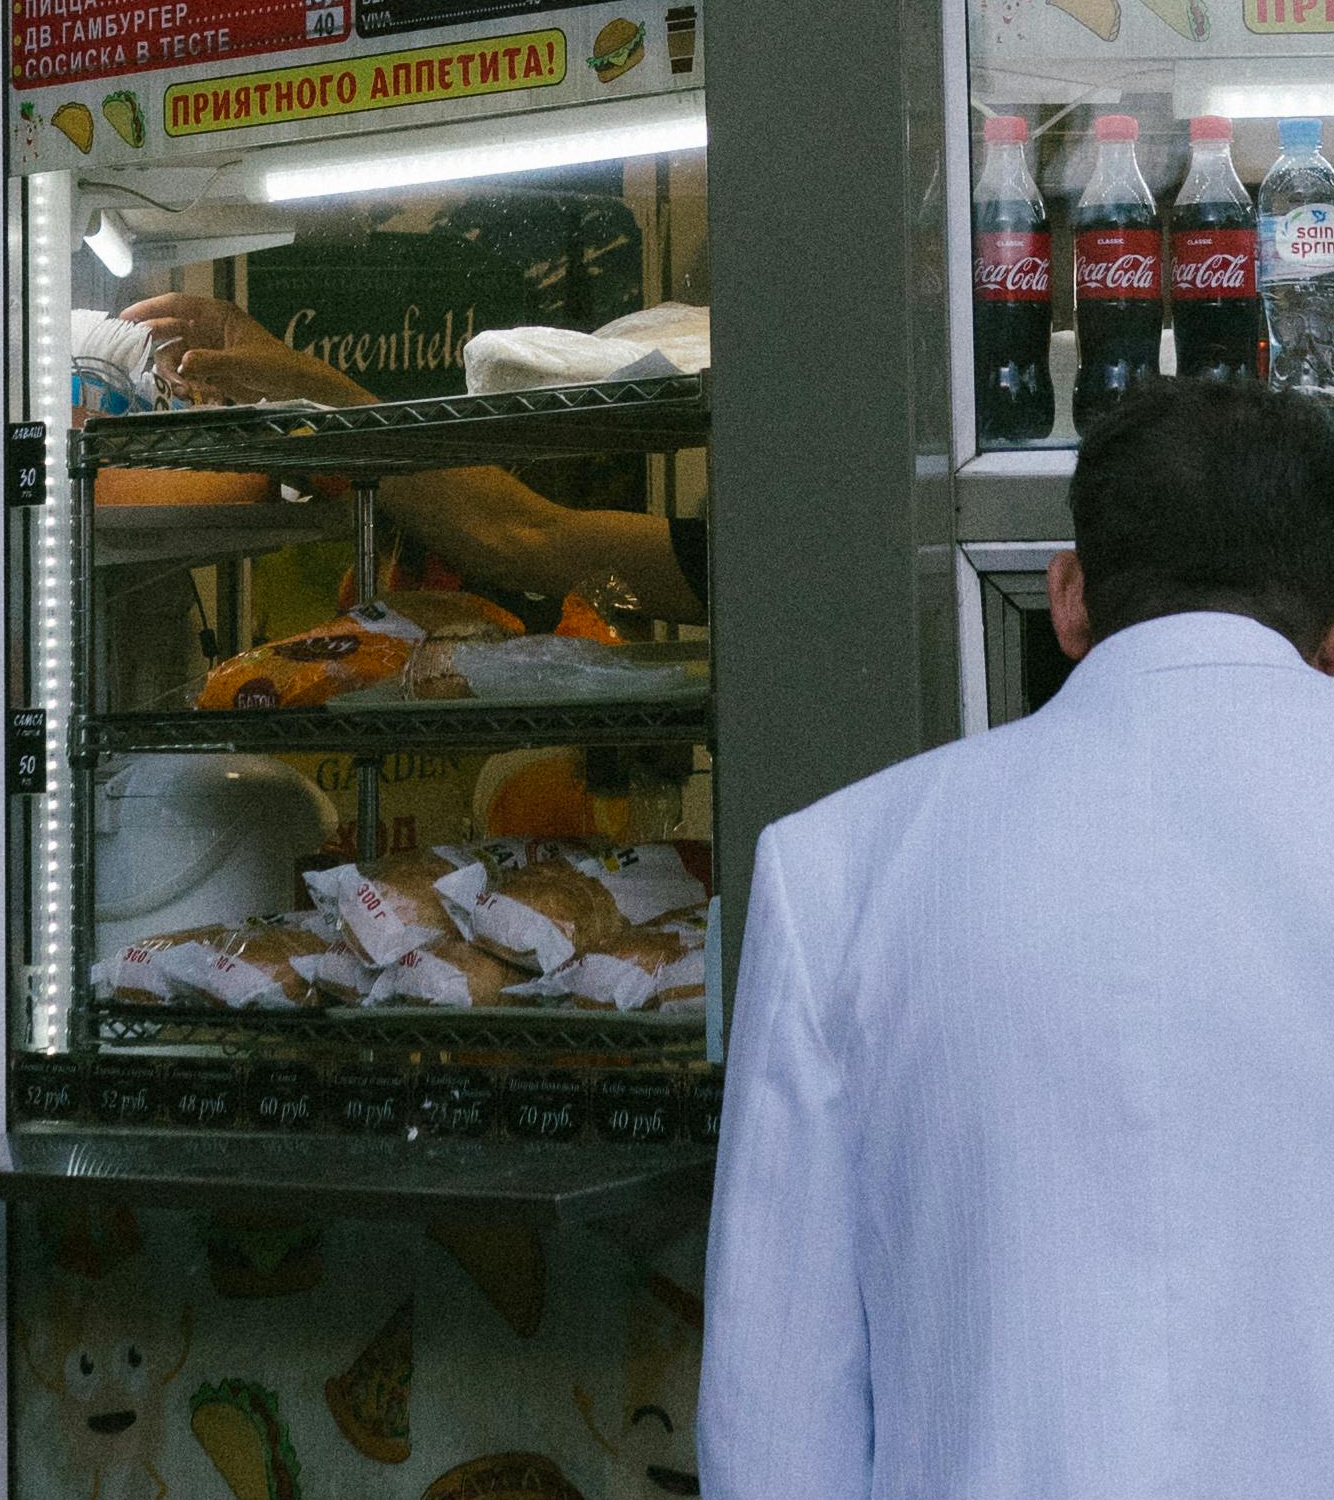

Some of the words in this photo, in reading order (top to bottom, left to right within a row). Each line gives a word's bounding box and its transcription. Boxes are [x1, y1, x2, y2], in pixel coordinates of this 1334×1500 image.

[171, 72, 358, 127] ПРИЯТНОГО
[372, 41, 557, 98] АППЕТИТА!
[19, 467, 36, 487] 30
[19, 756, 36, 774] 50
